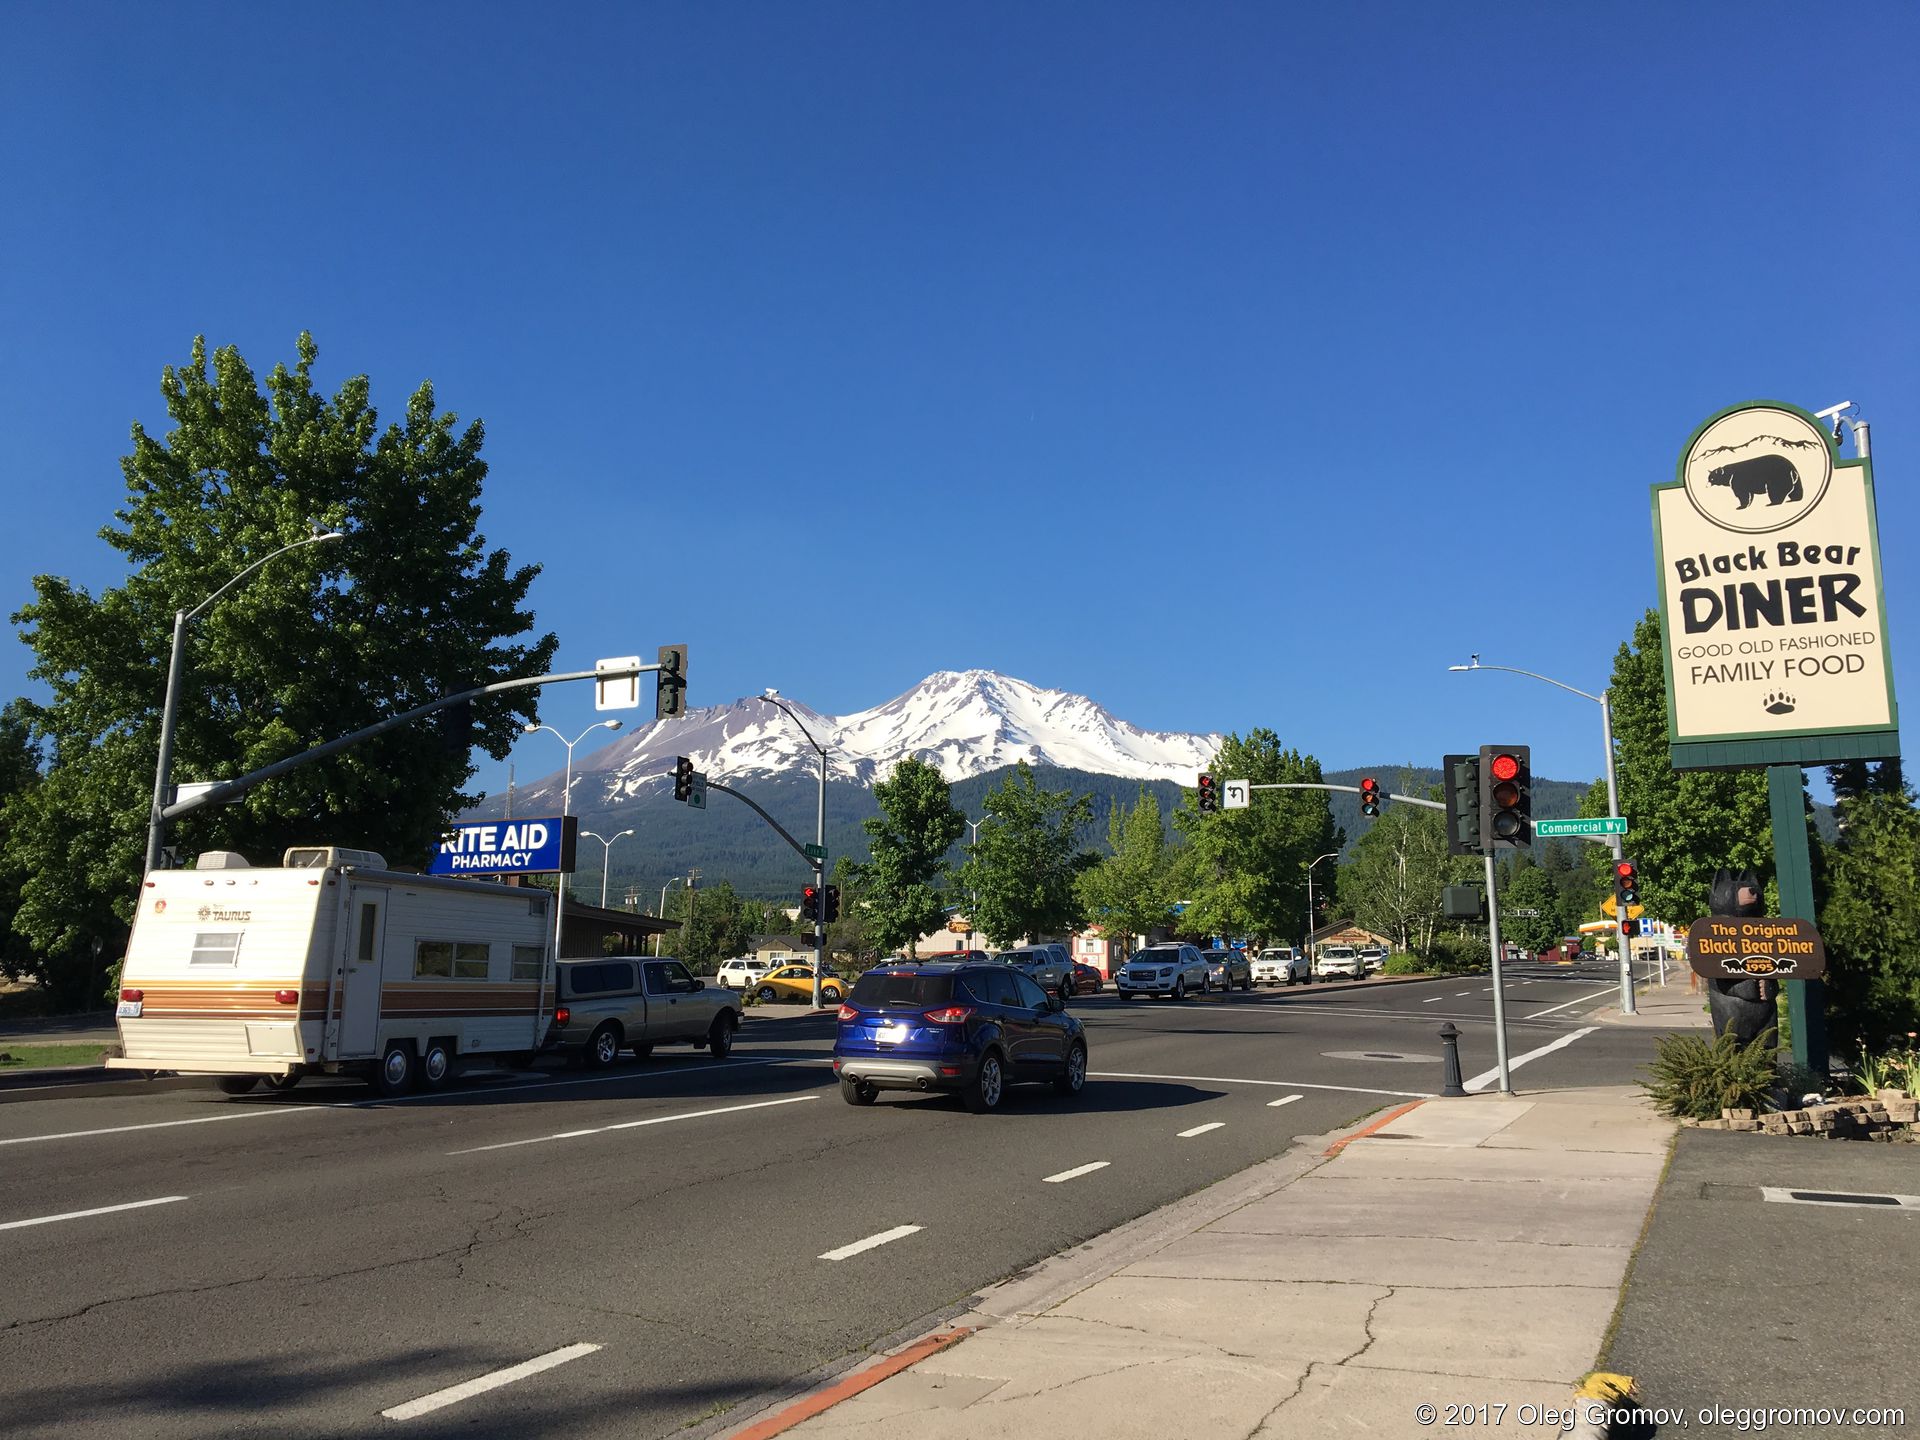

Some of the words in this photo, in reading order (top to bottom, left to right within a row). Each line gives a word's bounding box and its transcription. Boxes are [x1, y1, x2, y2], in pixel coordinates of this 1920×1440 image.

[1675, 546, 1767, 584] Black
[1777, 541, 1861, 568] Bear
[1680, 573, 1867, 634] DINER
[1678, 643, 1733, 660] GOOD
[1738, 640, 1774, 656] OLD
[1779, 631, 1876, 652] FASHIONED
[1691, 660, 1775, 685] FAMILY
[1785, 654, 1865, 678] FOOD
[1541, 822, 1601, 833] Commercial
[1606, 822, 1621, 834] Wy
[500, 823, 548, 851] AID
[452, 852, 532, 869] PHARMACY
[212, 911, 251, 921] TAURUS
[1711, 924, 1737, 936] The
[1742, 923, 1798, 938] Original
[1698, 938, 1737, 954] Black
[1740, 938, 1773, 954] Bear
[1777, 938, 1813, 954] Diner
[1745, 963, 1774, 971] 1995
